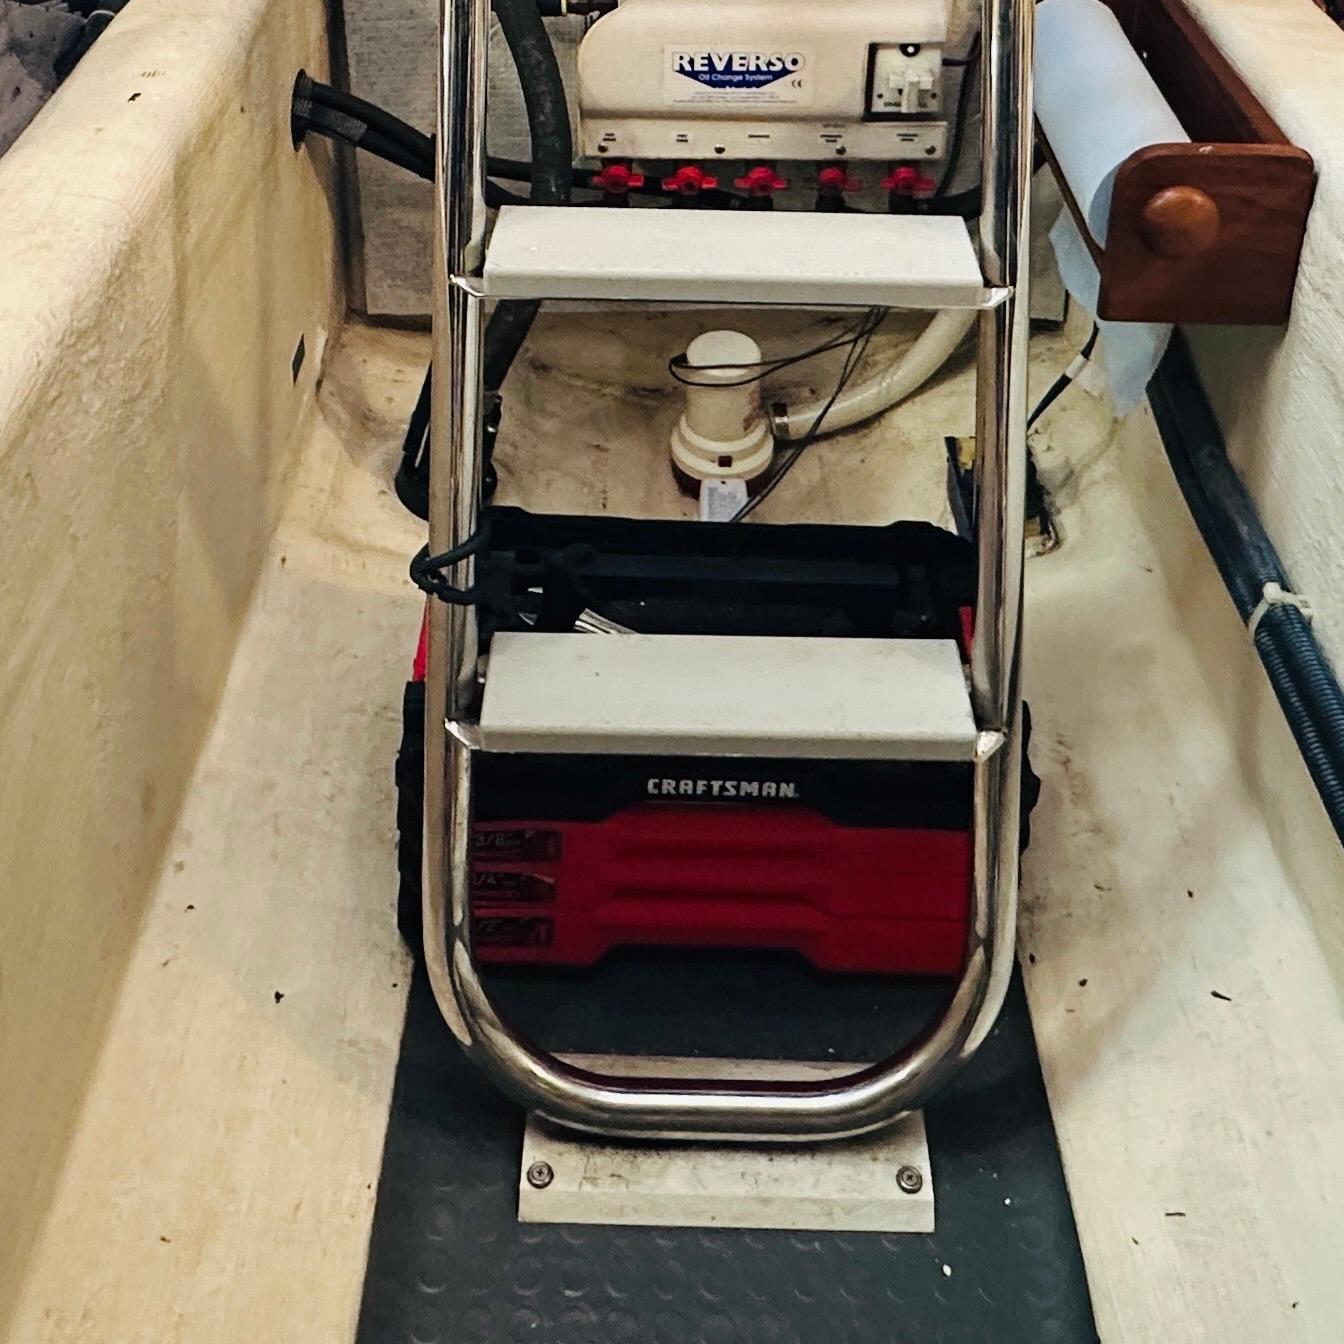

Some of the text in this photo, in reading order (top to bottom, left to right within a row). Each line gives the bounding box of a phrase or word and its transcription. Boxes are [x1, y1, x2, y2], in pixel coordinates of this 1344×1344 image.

[672, 52, 805, 72] REVERSO
[698, 73, 774, 83] Oil Change System
[647, 778, 797, 798] CRAFTSMAN
